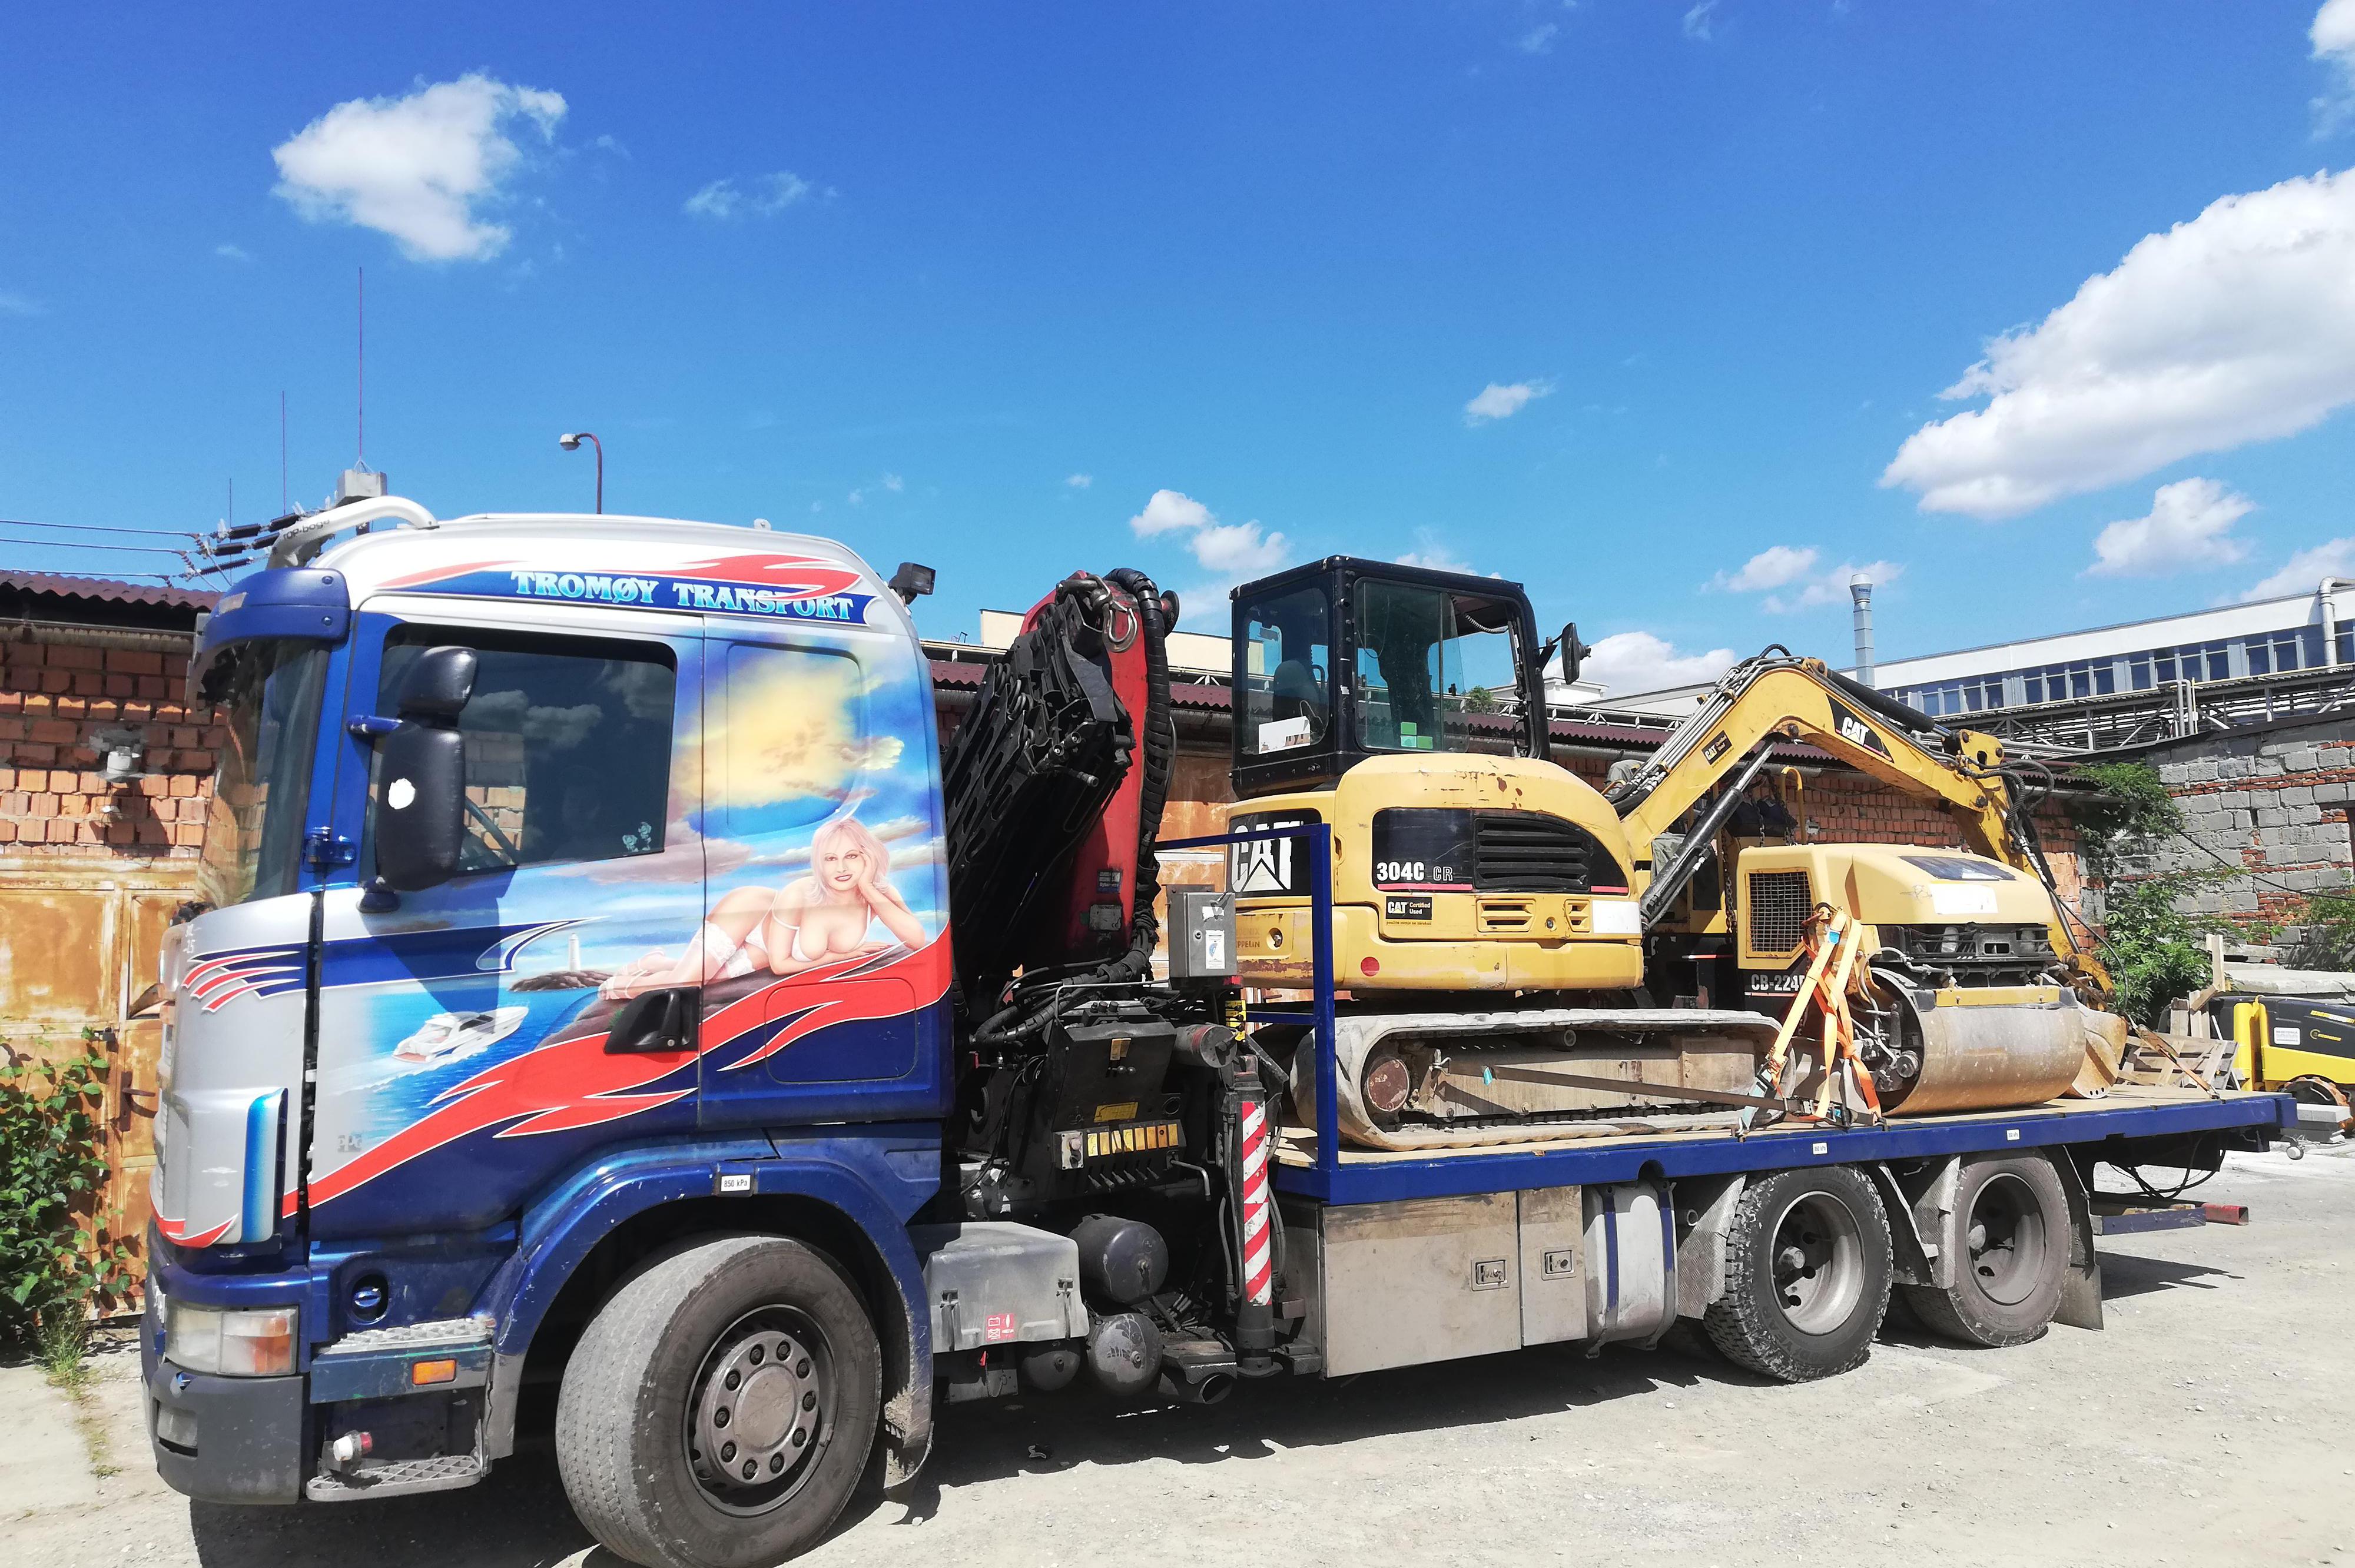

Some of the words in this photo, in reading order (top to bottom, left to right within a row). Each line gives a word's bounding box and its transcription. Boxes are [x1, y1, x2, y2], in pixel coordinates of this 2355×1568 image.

[510, 571, 659, 603] TROMØY
[672, 582, 854, 620] TRANSPORT
[1842, 716, 1870, 746] CAT
[1704, 744, 1717, 760] CAT
[1231, 820, 1300, 892] CAT
[1376, 862, 1425, 881] 304C
[1433, 866, 1453, 881] CR
[1388, 901, 1407, 914] CAT
[1236, 940, 1260, 948] PPELIN
[724, 1180, 735, 1188] 850
[737, 1178, 748, 1187] kPa
